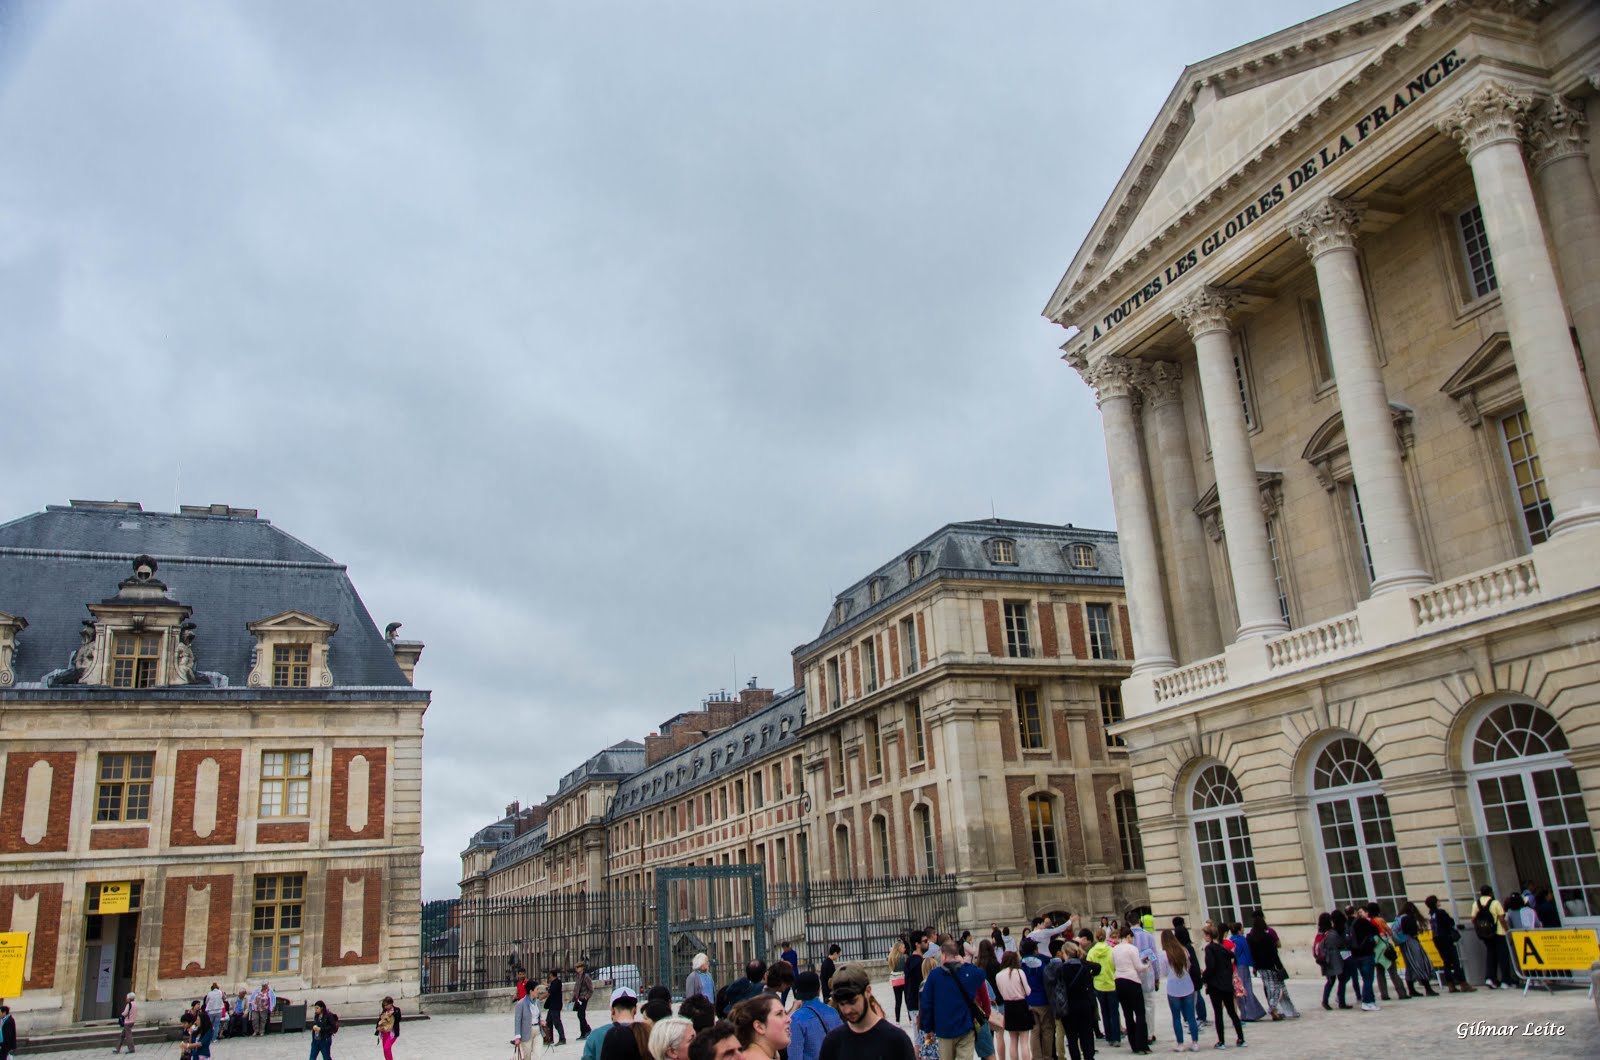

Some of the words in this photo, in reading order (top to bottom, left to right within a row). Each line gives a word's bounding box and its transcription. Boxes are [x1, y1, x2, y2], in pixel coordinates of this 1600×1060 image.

[1092, 325, 1102, 341] A
[1103, 276, 1163, 331] TOUTES
[1164, 249, 1198, 285] LES
[1201, 183, 1285, 257] GLOIRES
[1287, 157, 1318, 193] DE
[1319, 133, 1354, 169] LA
[1355, 49, 1466, 142] FRANCE.
[1523, 936, 1544, 965] A
